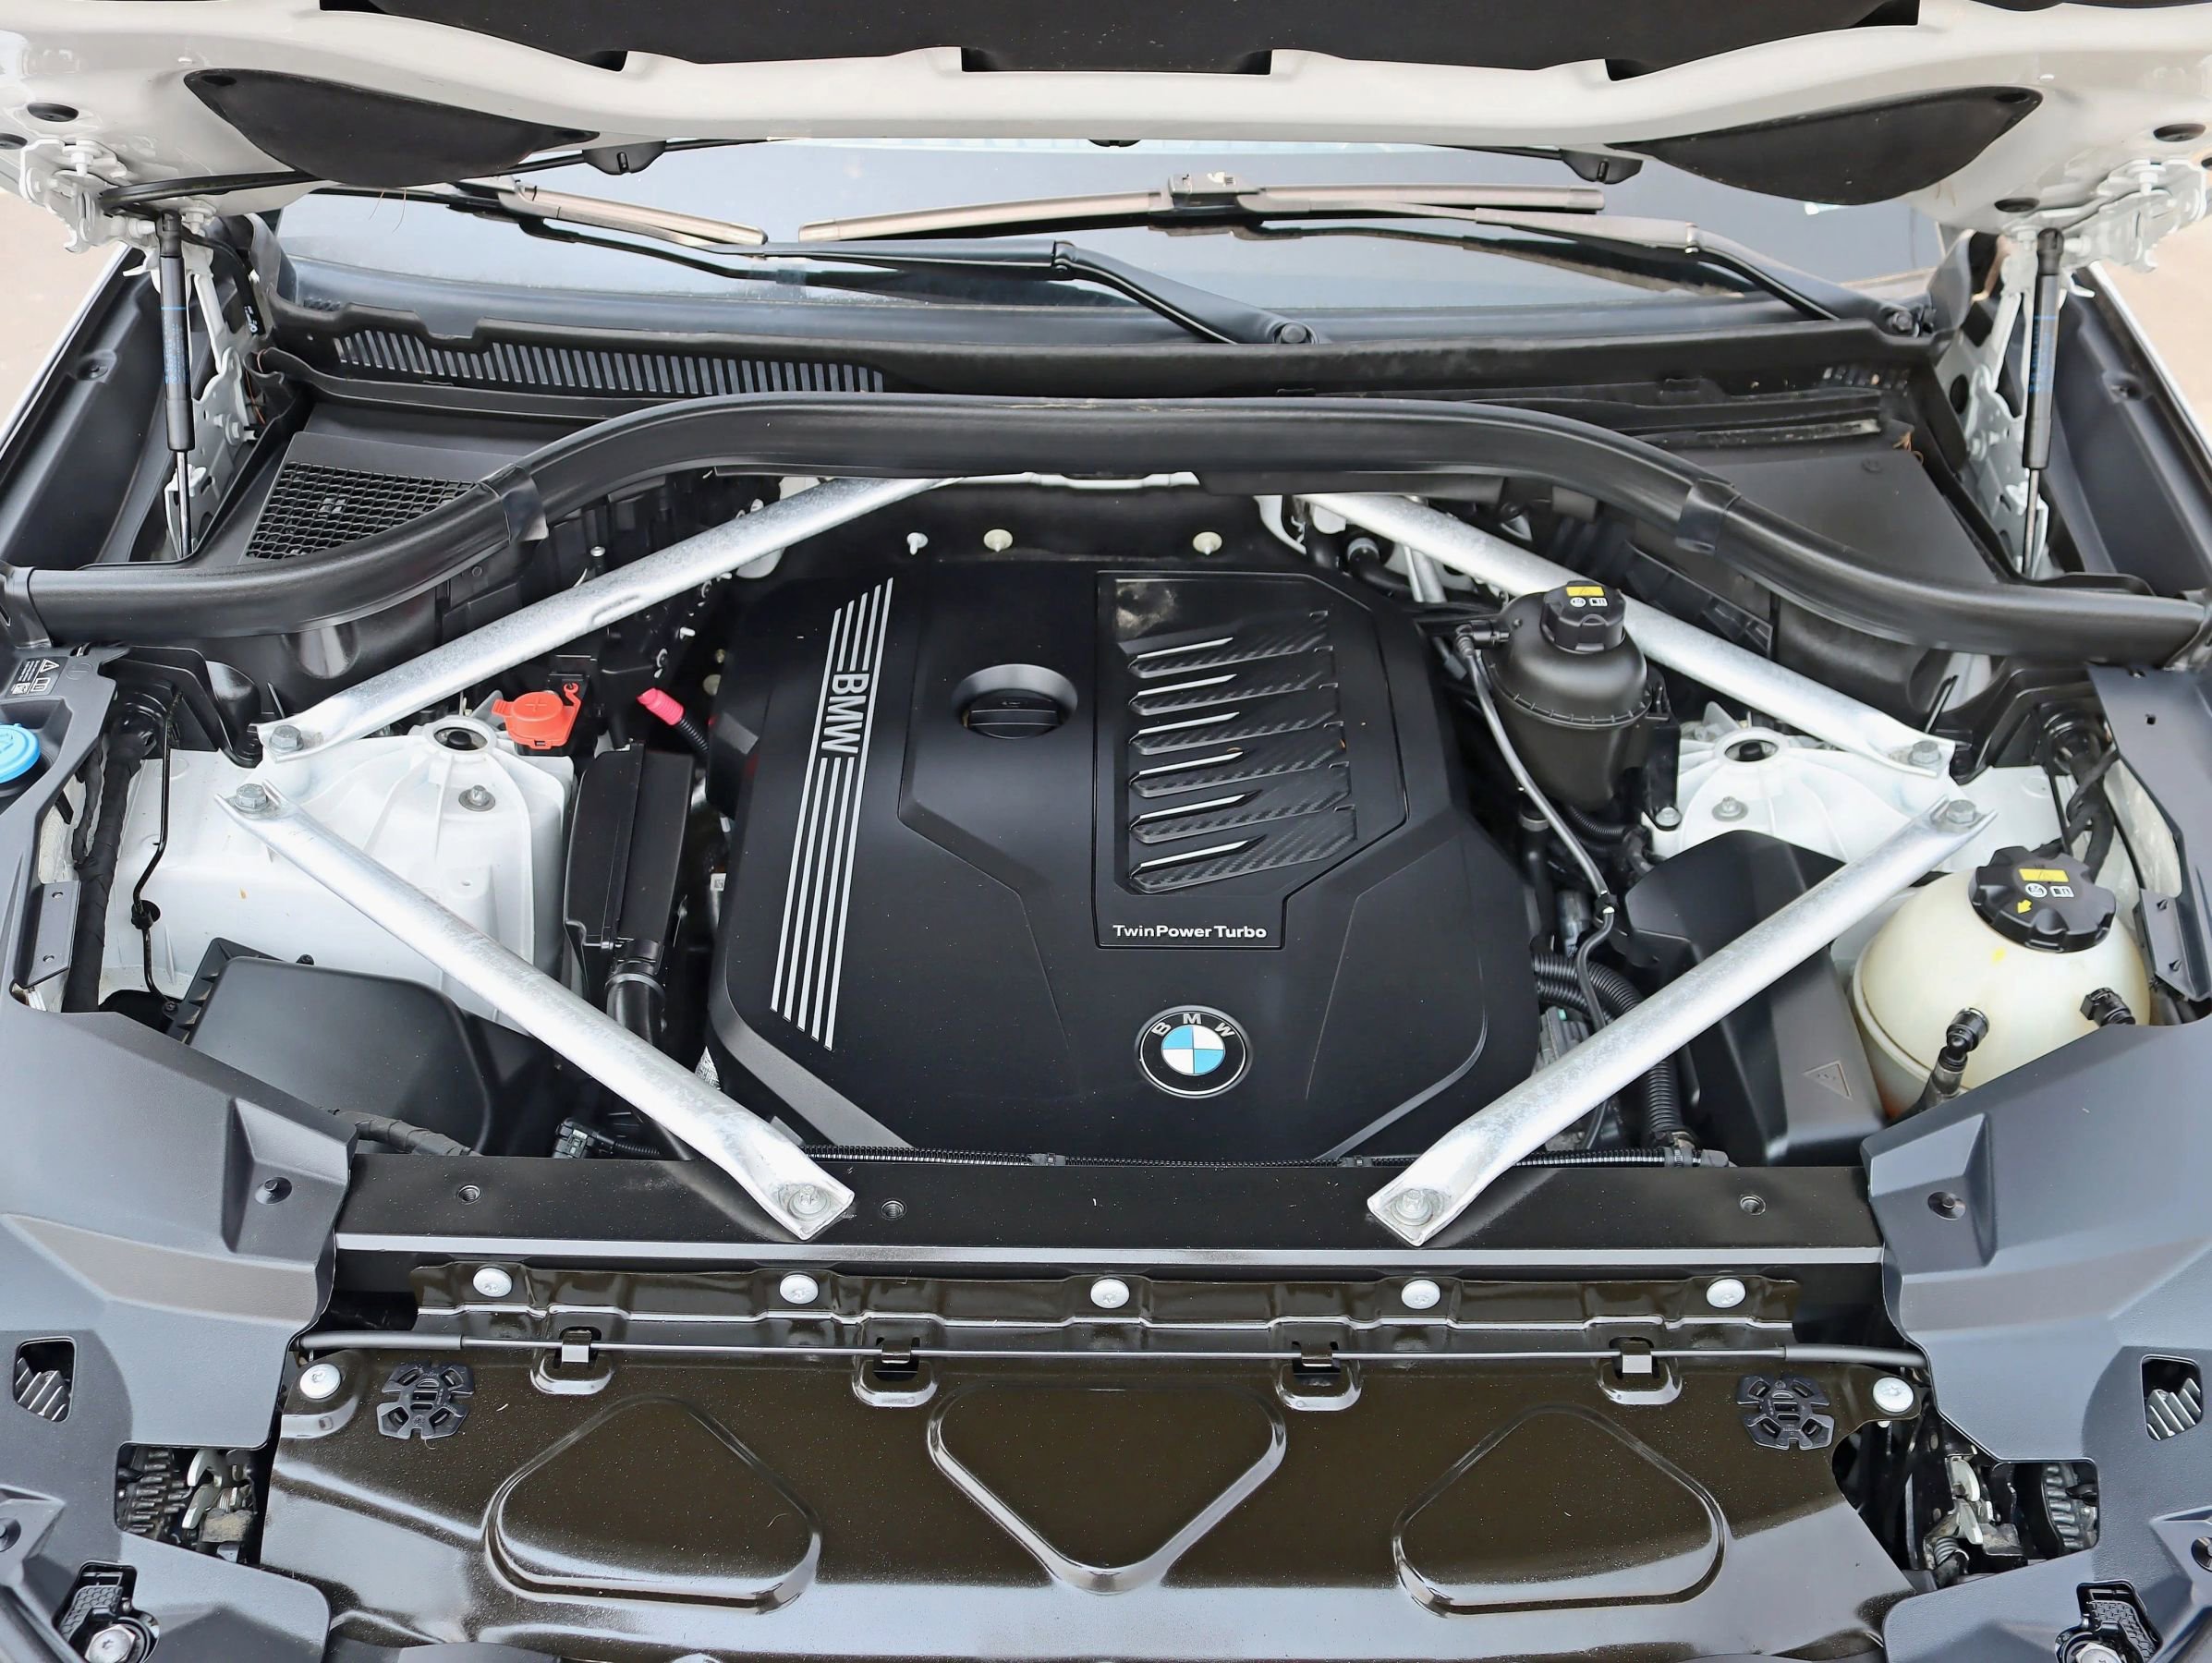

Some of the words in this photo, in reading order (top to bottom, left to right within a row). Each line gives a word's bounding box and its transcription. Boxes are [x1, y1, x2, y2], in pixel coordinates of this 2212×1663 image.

[820, 674, 869, 754] BMW
[1213, 926, 1268, 938] Turbo
[1151, 1013, 1235, 1037] BMW
